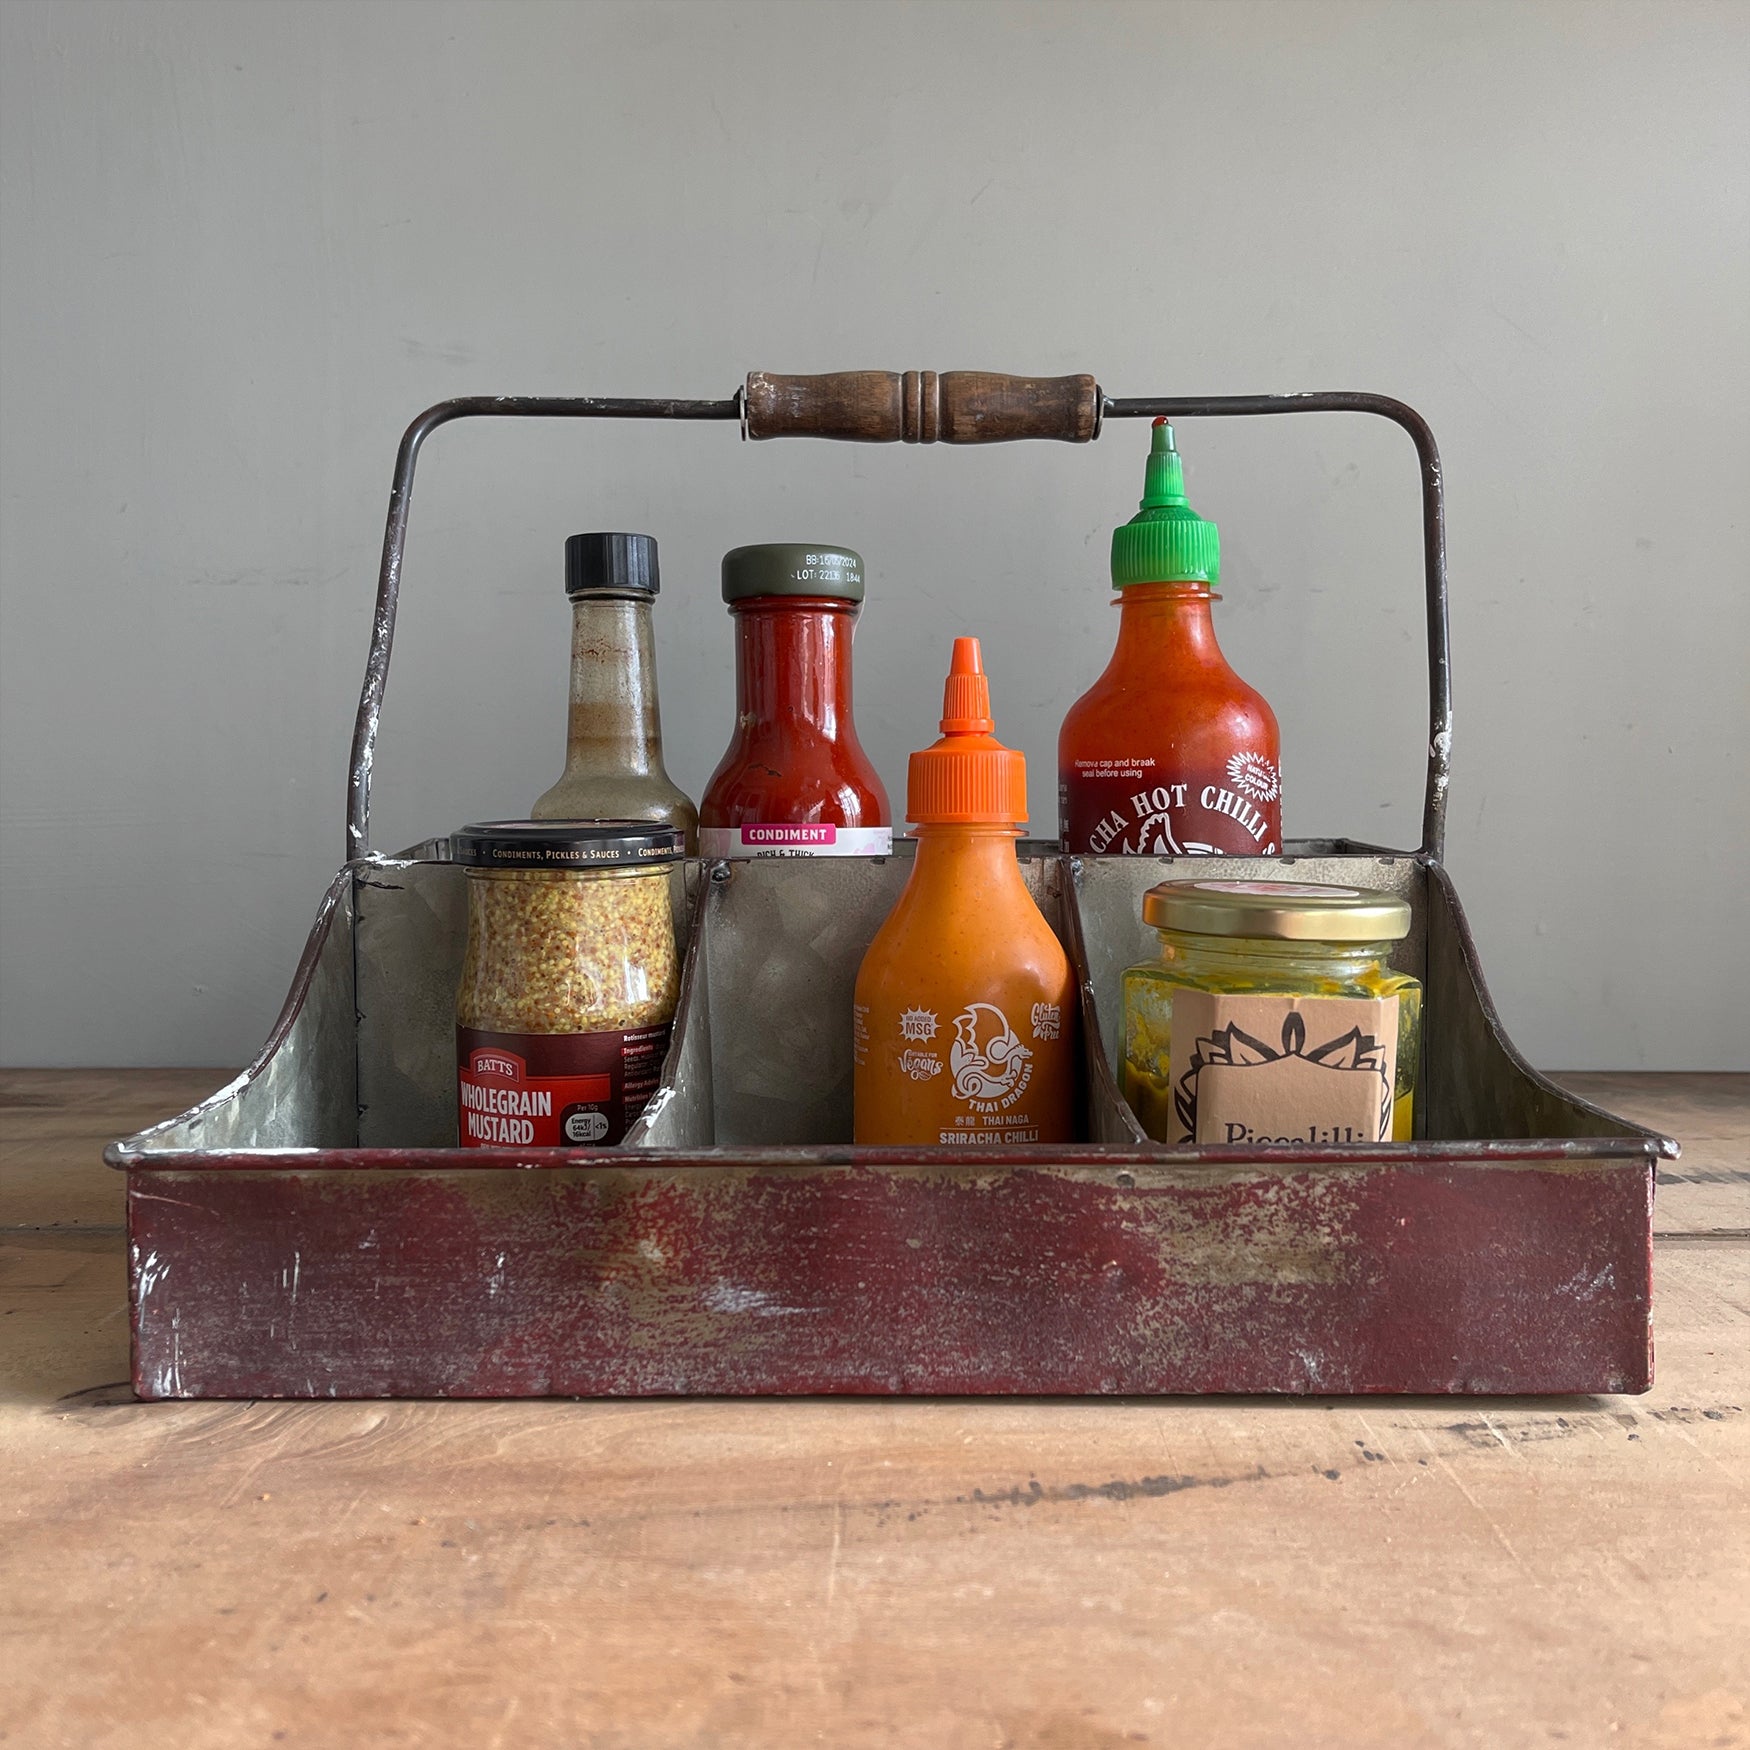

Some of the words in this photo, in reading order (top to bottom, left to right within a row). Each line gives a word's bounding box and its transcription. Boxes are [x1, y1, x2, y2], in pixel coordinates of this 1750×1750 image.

[797, 569, 817, 580] LOT:
[1099, 760, 1112, 768] cap
[1114, 758, 1129, 767] and
[1096, 768, 1118, 777] before
[1120, 768, 1142, 778] using
[1130, 784, 1187, 818] HOT
[1200, 785, 1268, 842] CHILLI
[749, 829, 827, 840] CONDIMENT
[545, 850, 580, 860] PICKLES
[582, 850, 588, 859] &
[589, 849, 620, 859] SAUCES
[906, 1023, 931, 1035] MSG
[477, 1058, 513, 1076] BATTS
[898, 1048, 944, 1075] Vegans
[969, 1099, 998, 1113] THAI
[1001, 1063, 1033, 1109] DRAGON
[461, 1080, 552, 1117] WHOLEGRAIN
[982, 1116, 1004, 1126] THAI
[1006, 1114, 1030, 1126] NAGA
[468, 1111, 535, 1145] MUSTARD
[939, 1132, 1002, 1144] SRIRACHA
[1005, 1130, 1039, 1143] CHILLI
